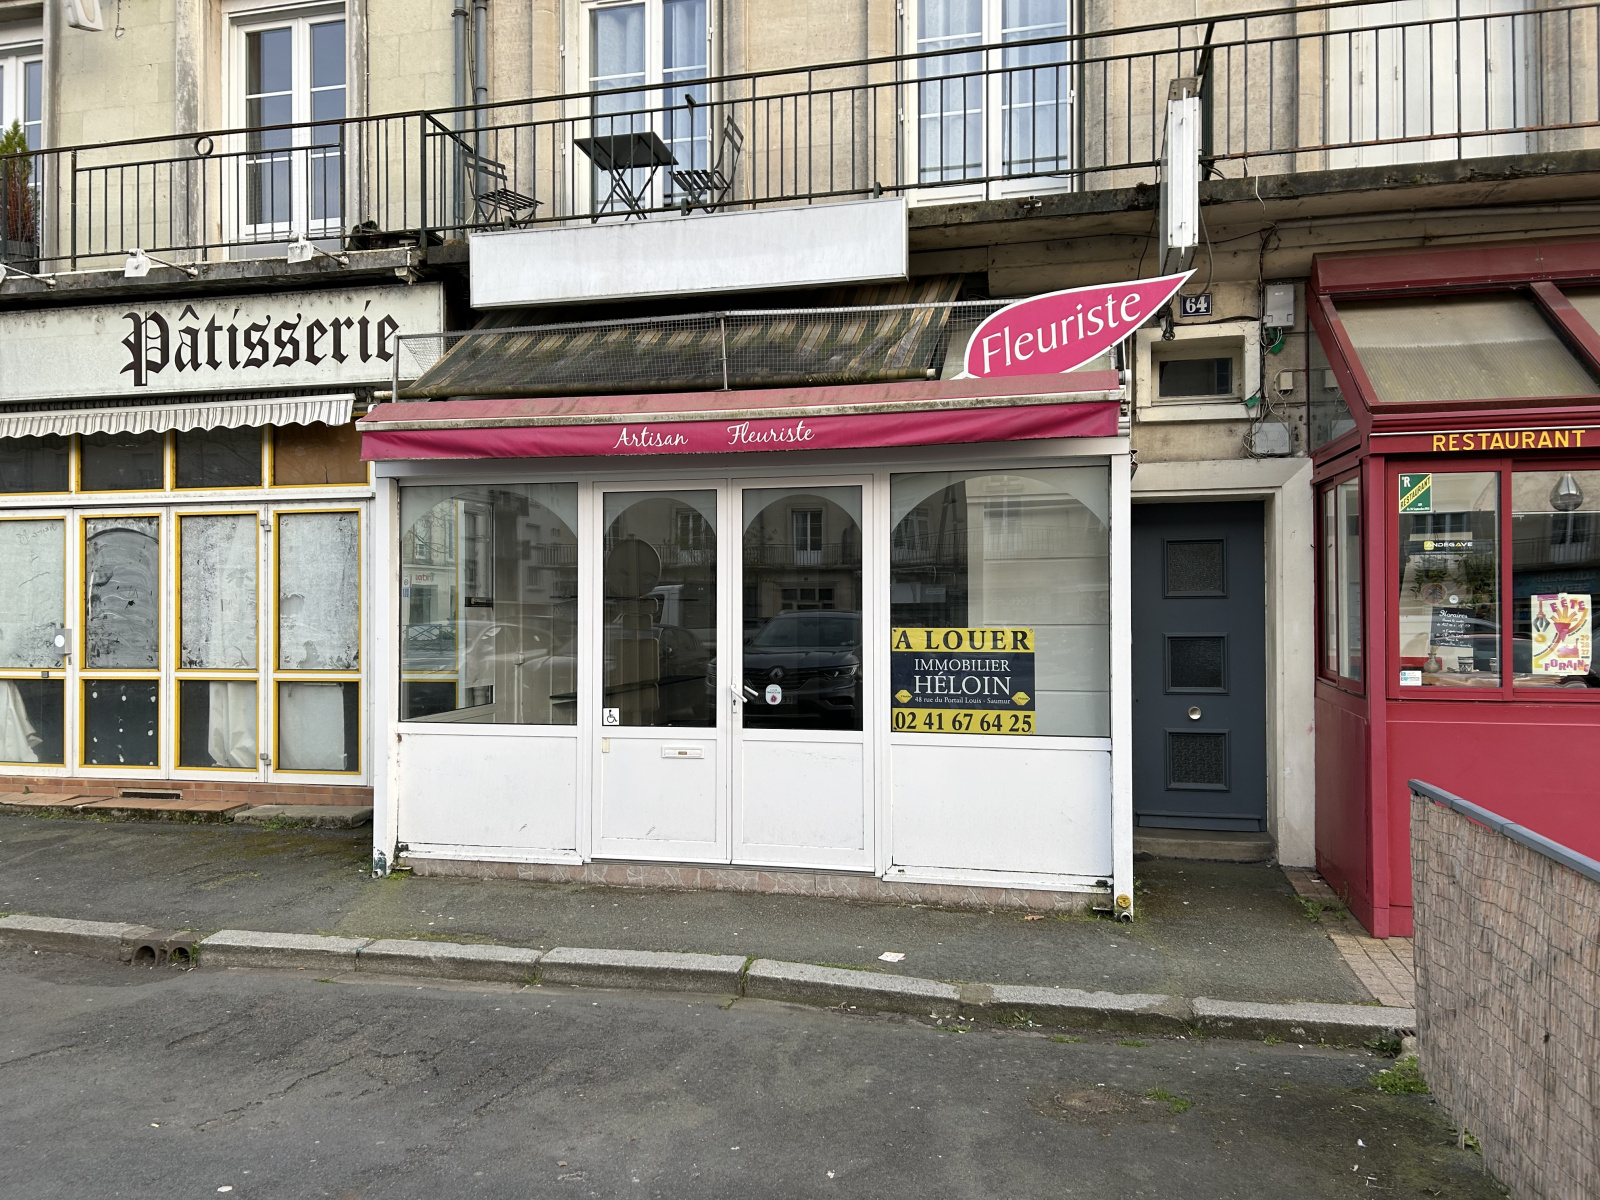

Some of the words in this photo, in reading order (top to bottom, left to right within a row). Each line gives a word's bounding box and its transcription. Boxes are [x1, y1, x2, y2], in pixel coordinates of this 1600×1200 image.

[1186, 296, 1207, 313] 64
[120, 300, 400, 387] Pâtisserie
[982, 293, 1142, 375] Fleuriste
[613, 426, 689, 449] Artisan
[727, 420, 815, 446] Fleuriste
[1432, 429, 1586, 452] RESTAURANT
[1400, 475, 1431, 510] RESTAURANT
[894, 630, 913, 650] A
[924, 630, 1030, 651] LOUER
[914, 658, 1011, 672] IMMOBILIER
[1544, 658, 1590, 673] FORAINE
[913, 671, 1012, 696] HÉLOIN
[987, 697, 1011, 705] Saumur
[895, 711, 917, 730] 02
[923, 712, 944, 731] 41
[952, 712, 973, 731] 67
[980, 713, 1002, 732] 64
[1009, 714, 1032, 733] 25
